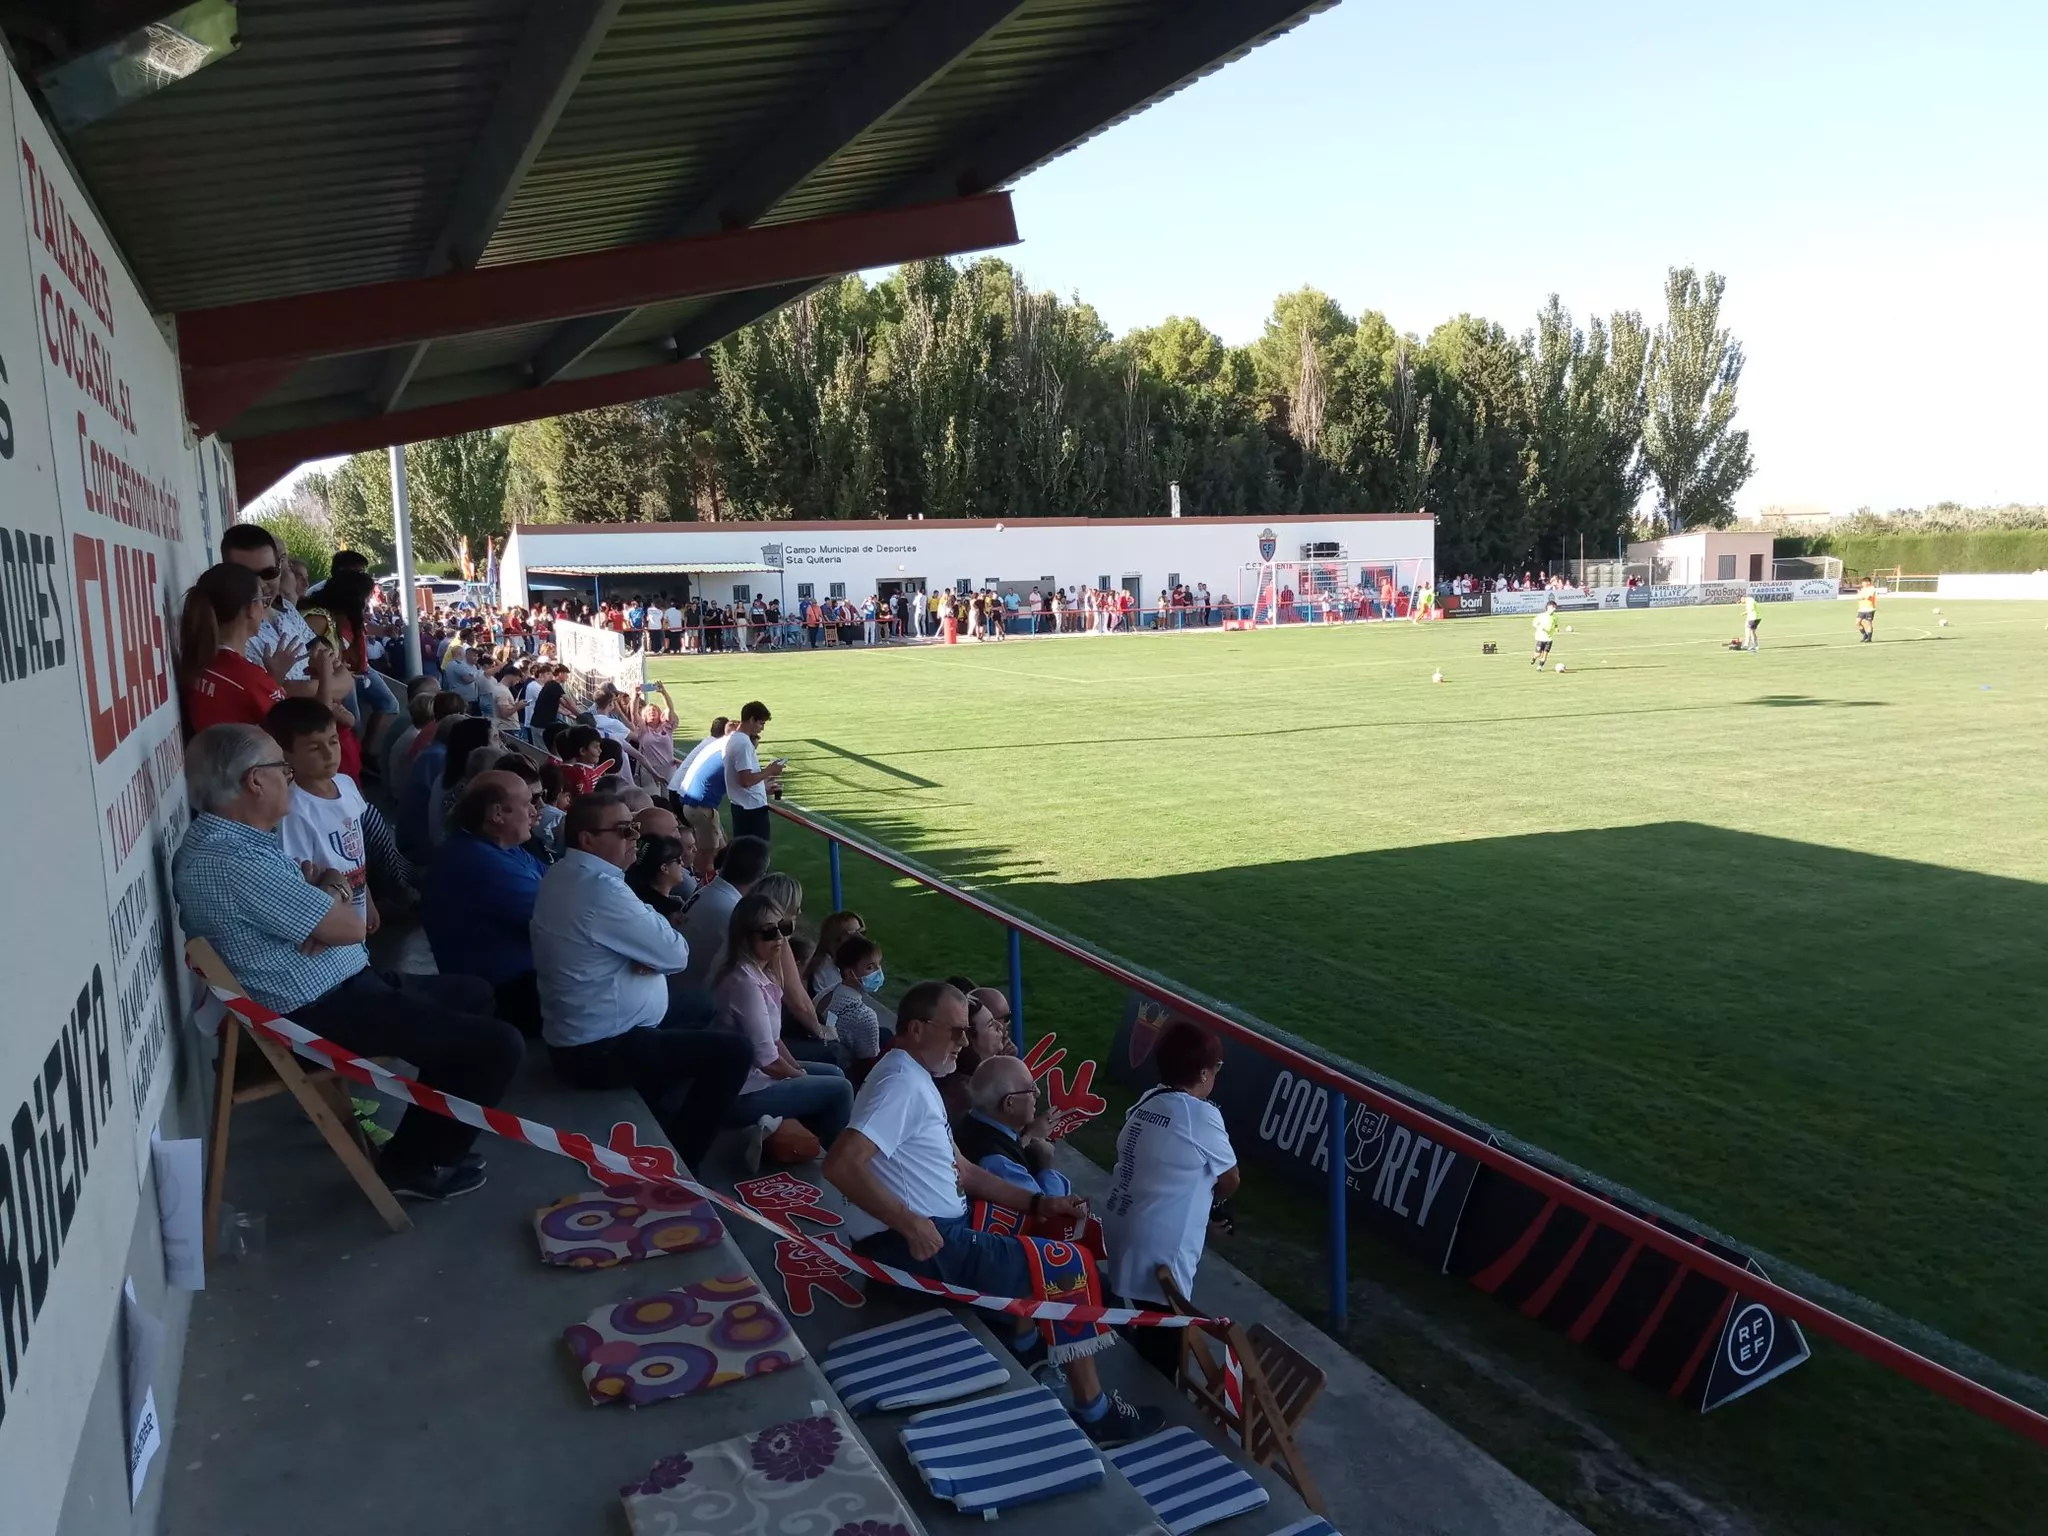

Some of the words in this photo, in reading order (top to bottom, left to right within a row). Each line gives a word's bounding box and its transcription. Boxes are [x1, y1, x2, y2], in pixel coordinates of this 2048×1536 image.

[21, 136, 114, 337] TALLERES
[785, 545, 816, 554] Campo
[820, 545, 859, 554] Municipal
[863, 545, 873, 553] de
[877, 545, 917, 554] Deportes
[786, 556, 803, 564] Sta
[807, 556, 842, 564] Quiteria
[74, 532, 169, 764] CLAAS
[1346, 1175, 1360, 1191] EL
[1372, 1125, 1456, 1228] REY
